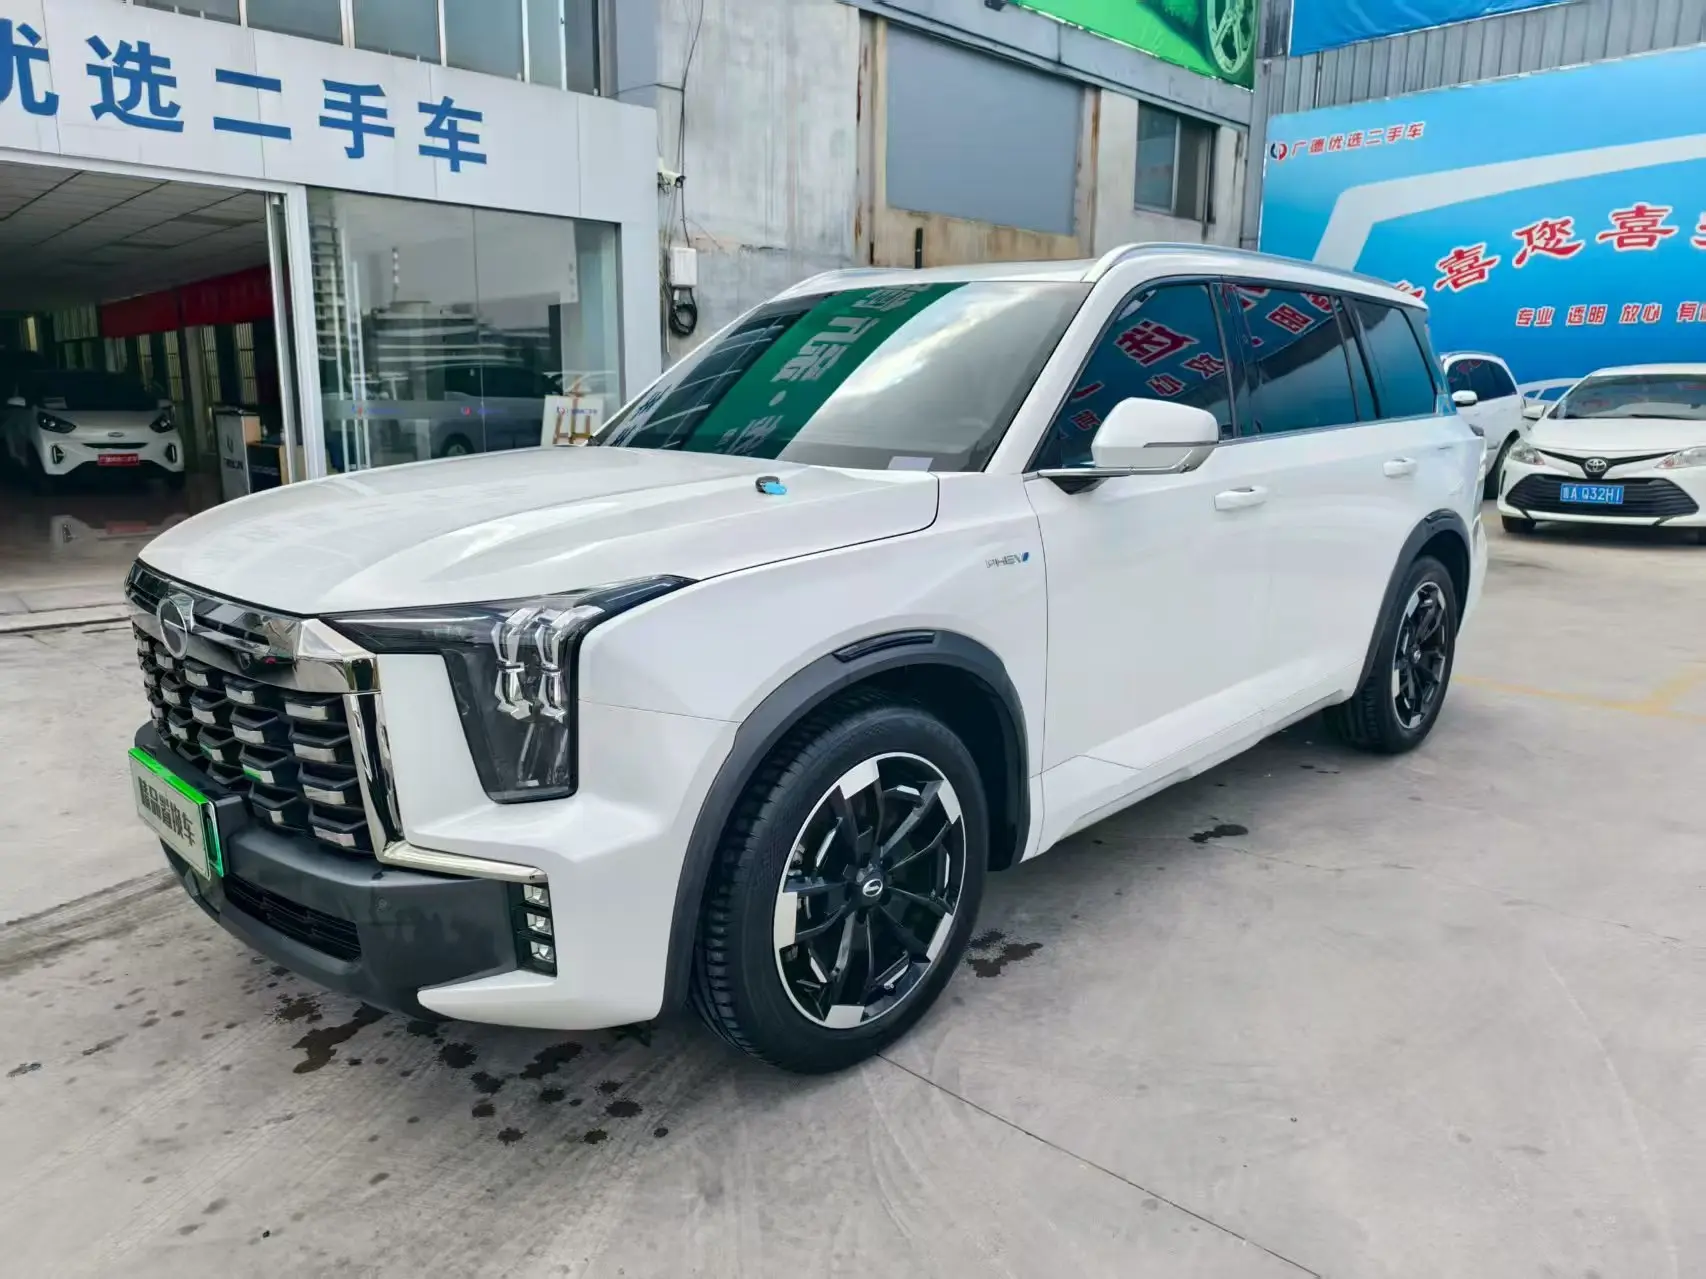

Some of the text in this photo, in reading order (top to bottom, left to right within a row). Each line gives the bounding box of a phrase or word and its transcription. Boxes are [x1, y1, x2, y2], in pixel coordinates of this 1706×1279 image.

[0, 18, 487, 172] 优选二手车
[1395, 202, 1706, 299] 喜您喜
[1516, 306, 1555, 327] 专业
[1566, 304, 1608, 326] 透明
[1619, 303, 1662, 324] 放心
[985, 552, 1029, 568] PHEV
